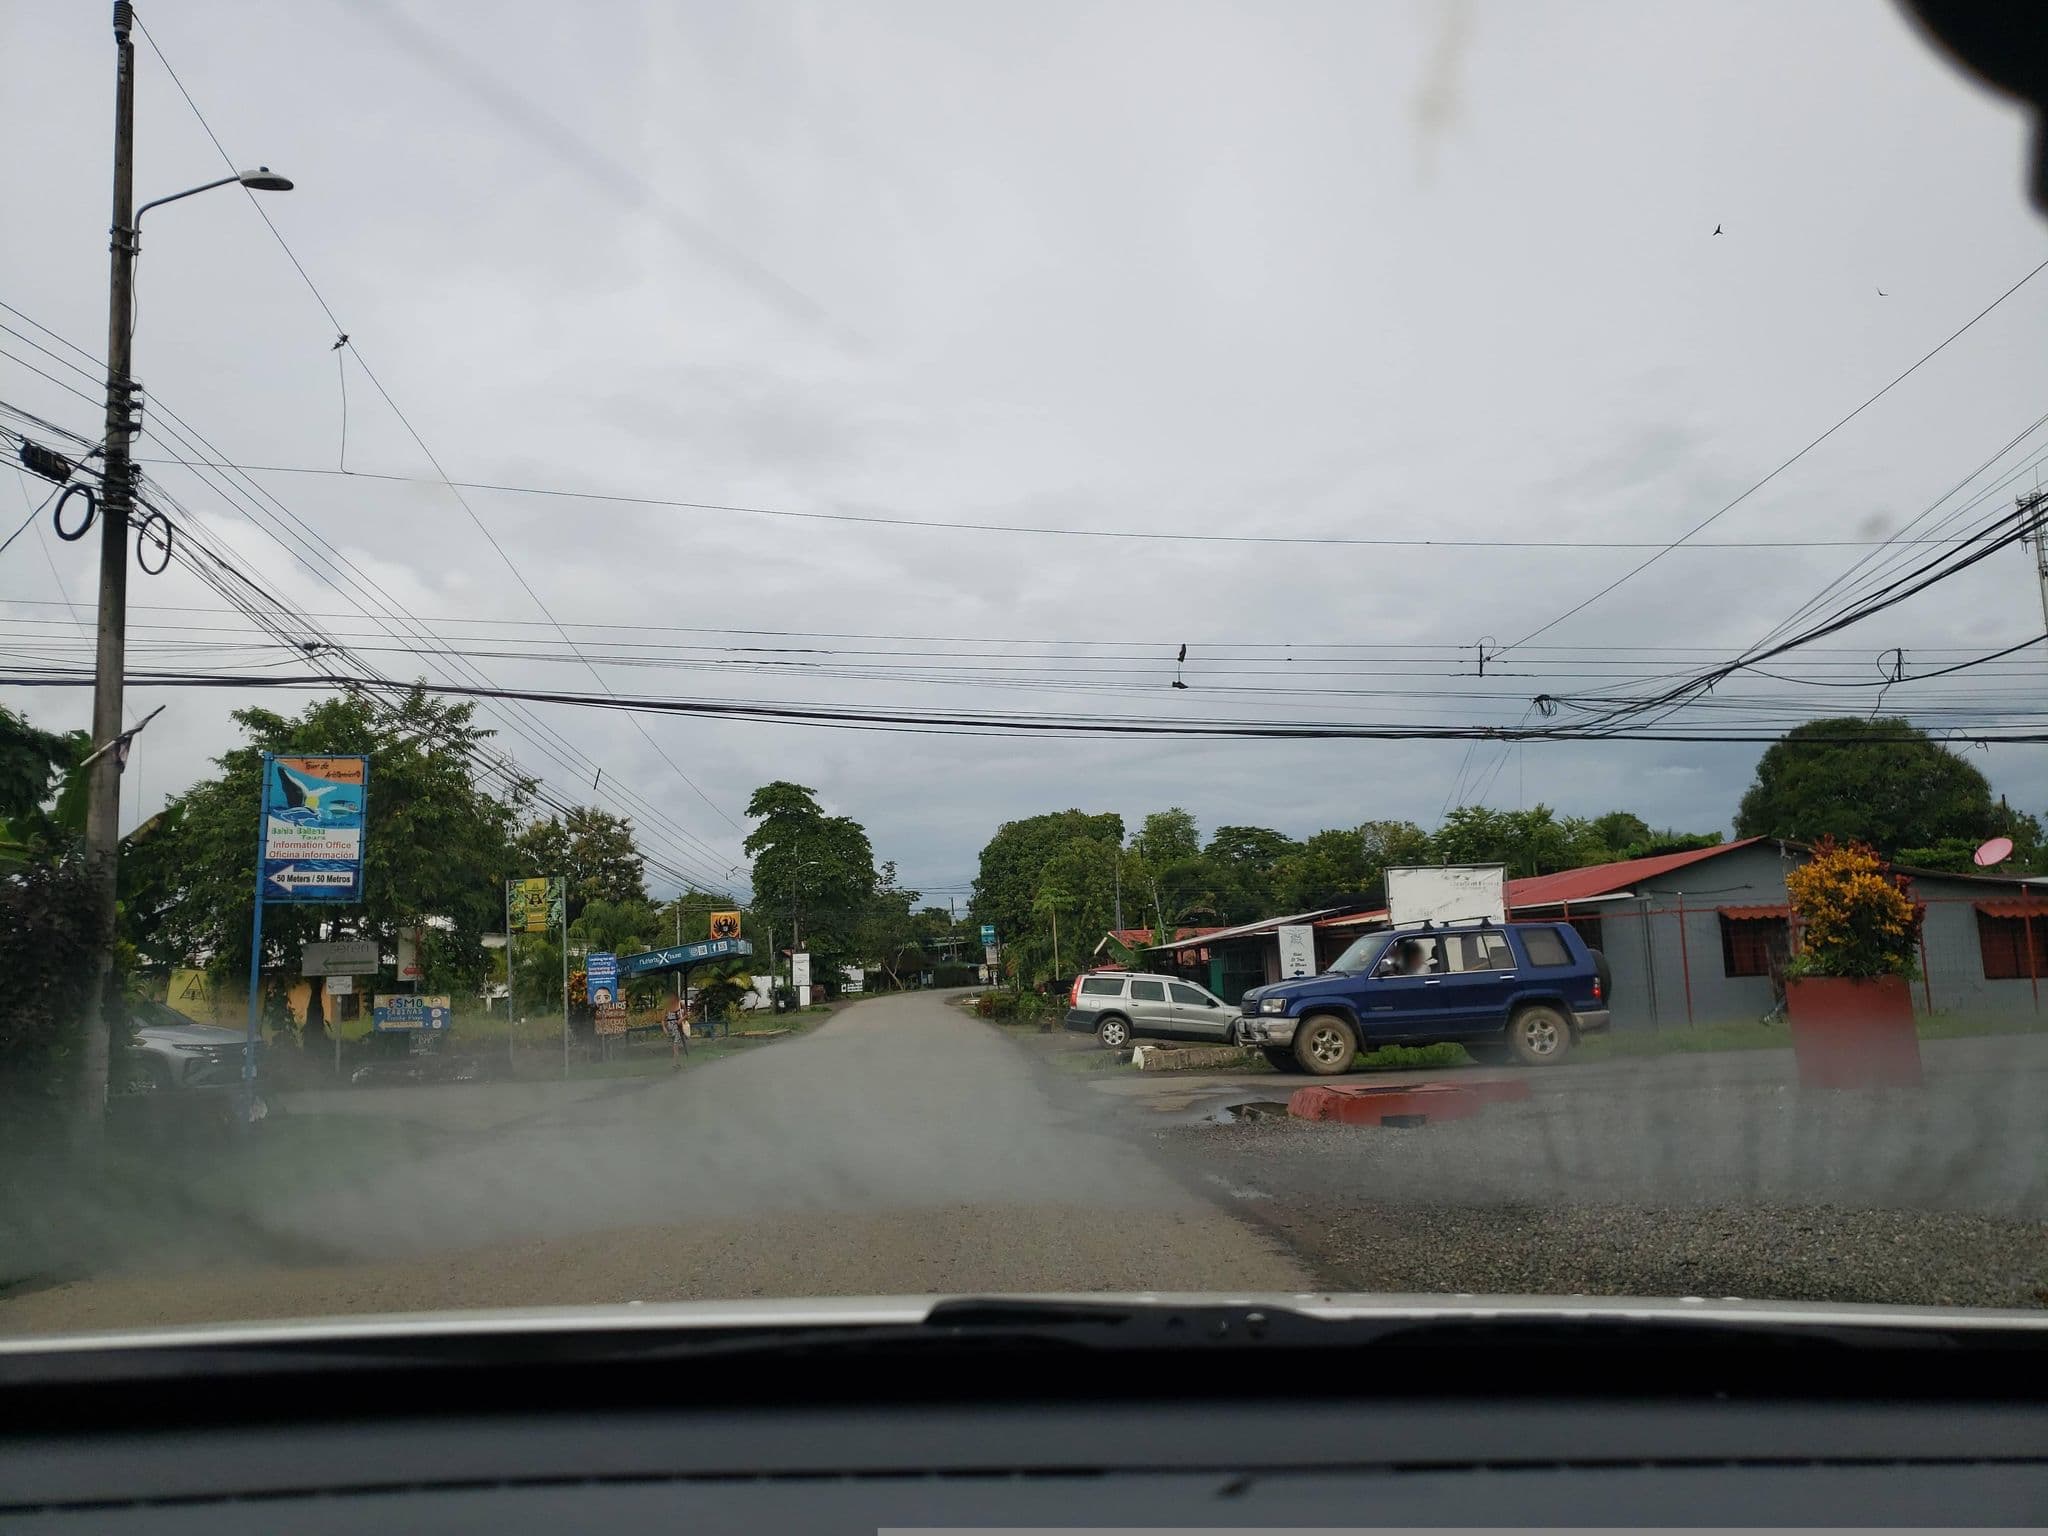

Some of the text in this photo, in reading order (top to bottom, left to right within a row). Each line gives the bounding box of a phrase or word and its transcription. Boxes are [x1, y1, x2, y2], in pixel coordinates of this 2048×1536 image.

[273, 841, 352, 849] Information Office
[269, 850, 300, 858] Oficina
[287, 875, 311, 883] Meters
[316, 875, 325, 883] 50
[326, 875, 351, 883] Metros
